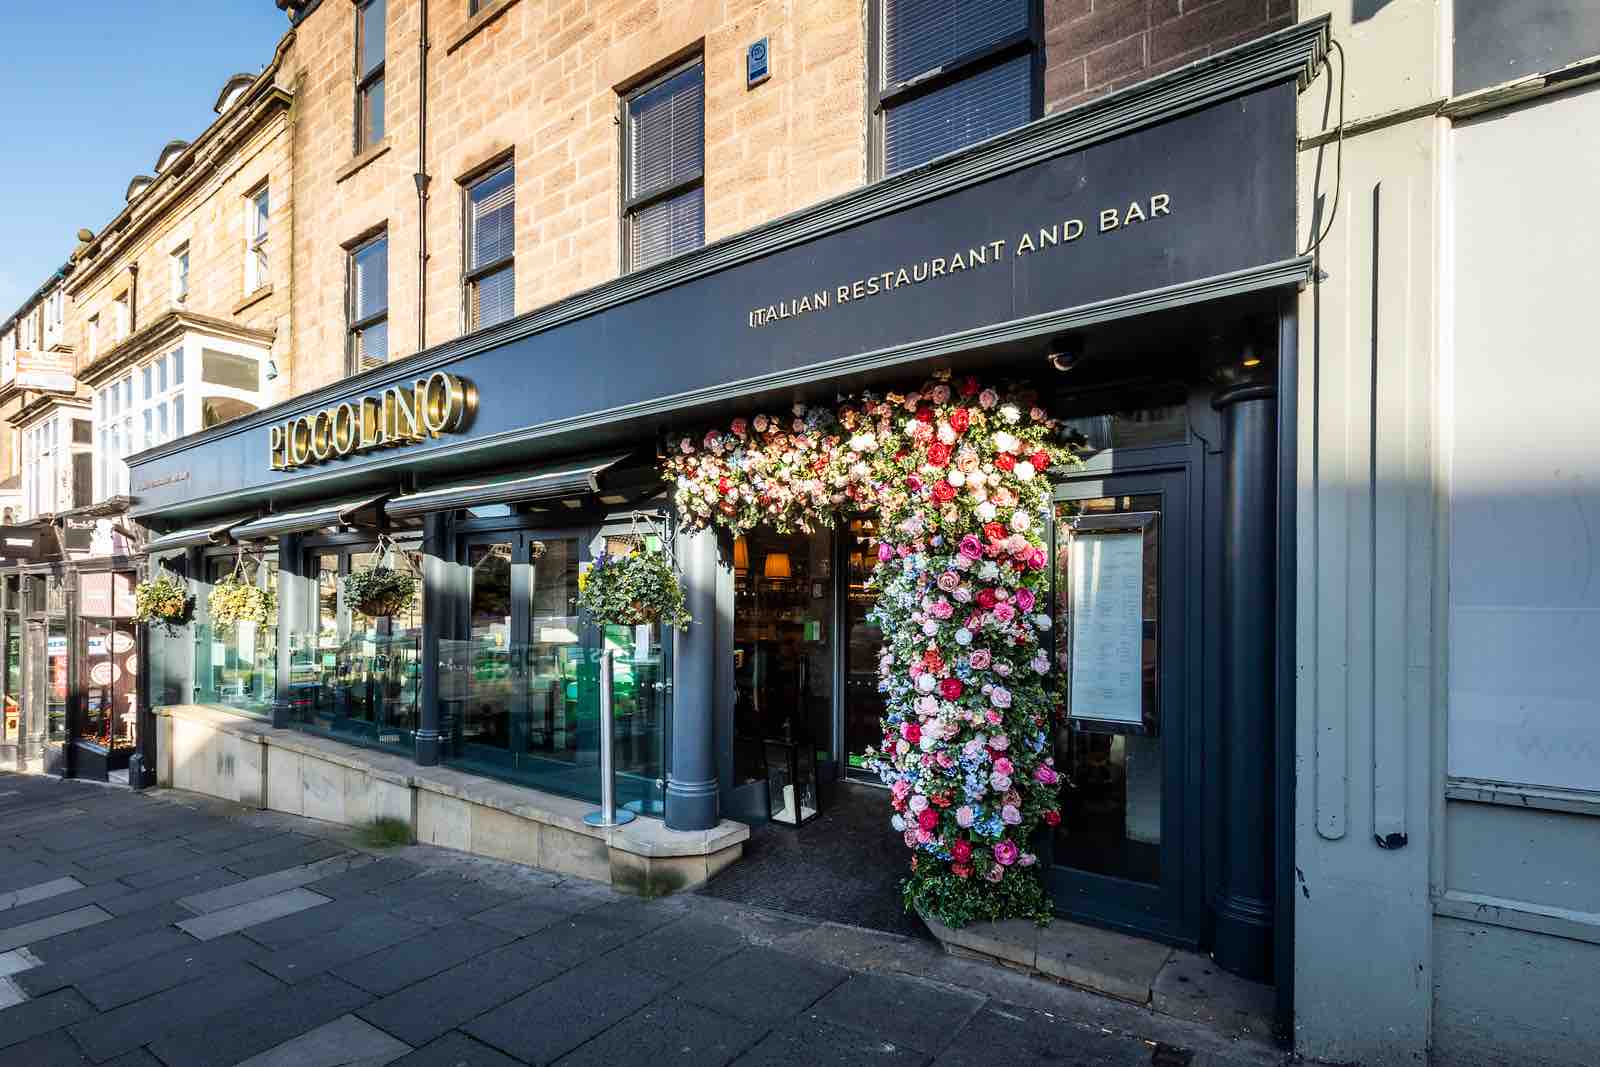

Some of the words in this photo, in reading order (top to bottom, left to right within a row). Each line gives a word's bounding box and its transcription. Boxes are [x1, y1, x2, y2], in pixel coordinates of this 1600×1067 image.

[749, 290, 829, 328] ITALIAN
[837, 240, 1006, 303] RESTAURANT
[1017, 219, 1084, 256] AND
[1100, 193, 1170, 233] BAR
[270, 371, 468, 471] PICCOLINO
